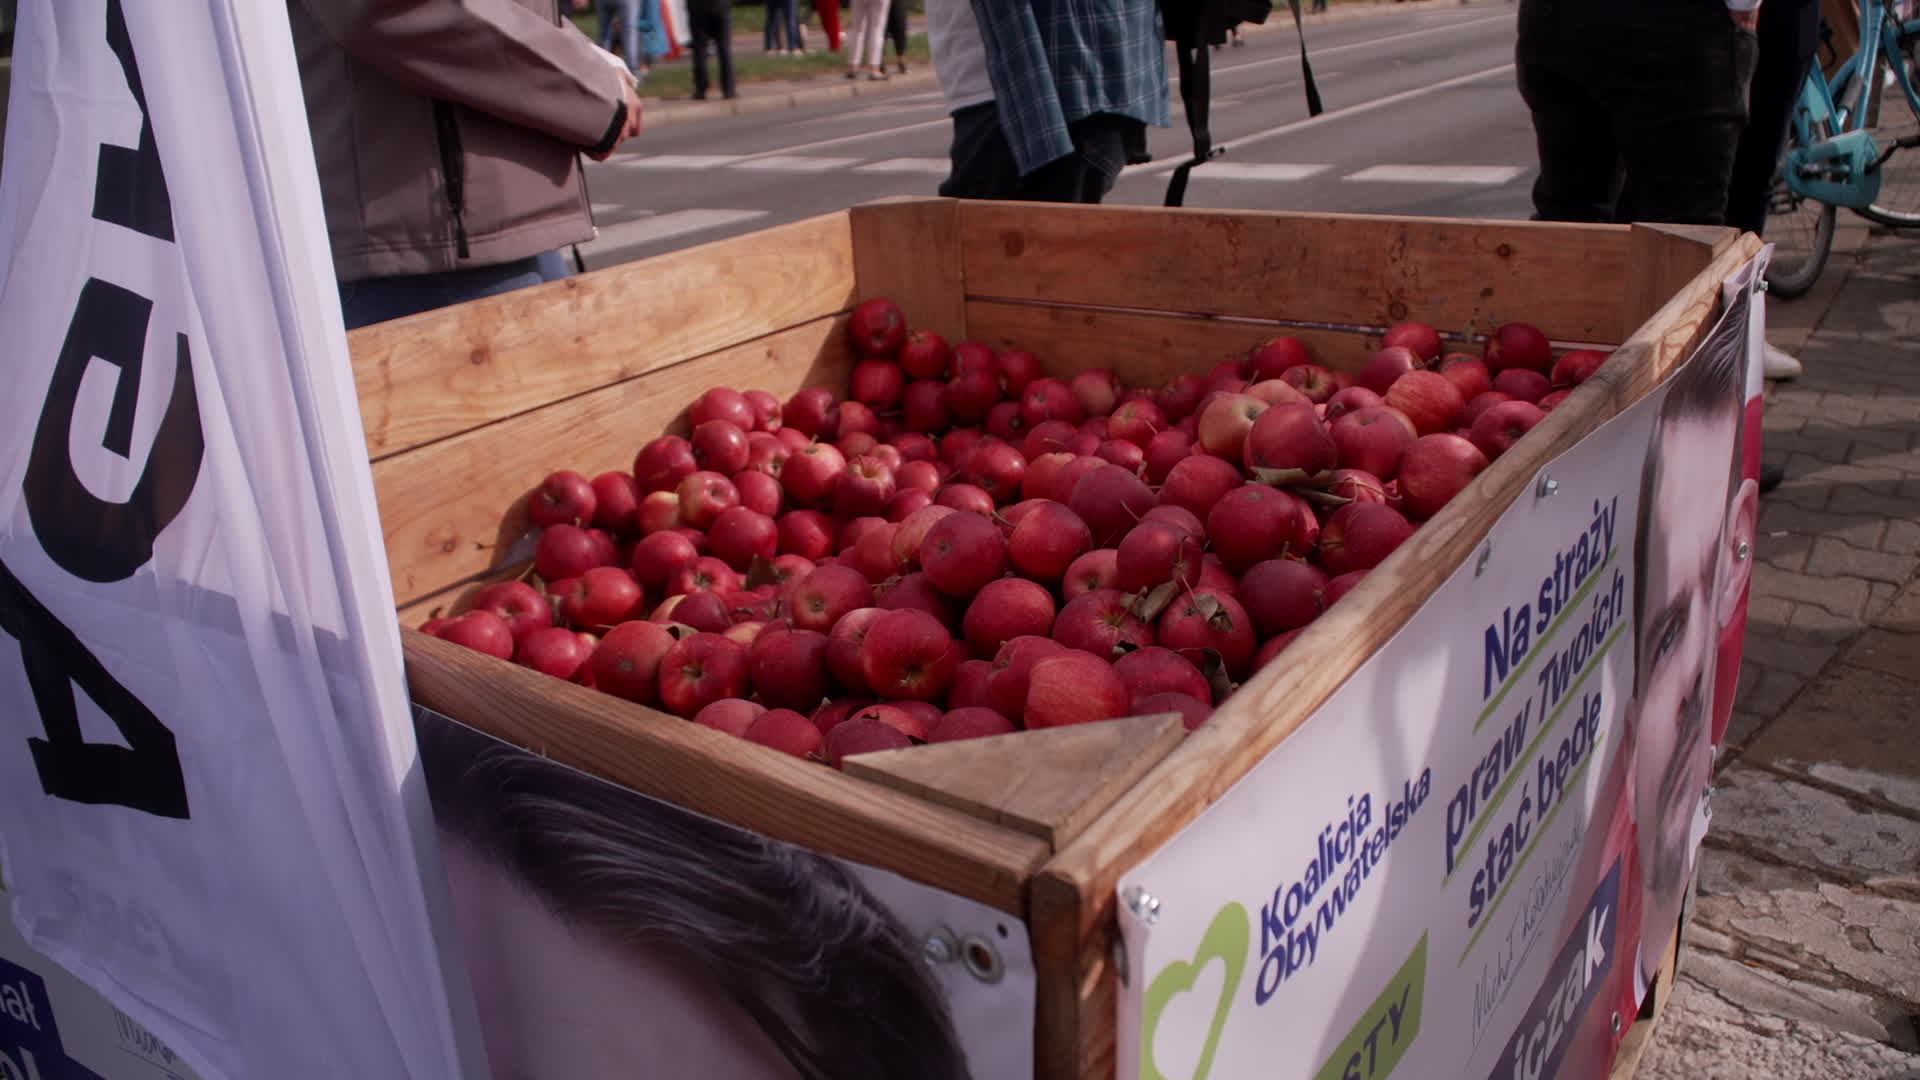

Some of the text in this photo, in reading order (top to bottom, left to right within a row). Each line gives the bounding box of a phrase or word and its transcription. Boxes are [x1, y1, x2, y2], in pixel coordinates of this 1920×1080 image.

[1483, 496, 1618, 700] Na straży
[1446, 697, 1533, 876] praw
[1538, 568, 1625, 725] Twoich
[1468, 782, 1532, 928] stać
[1537, 691, 1603, 822] będę
[1255, 767, 1431, 1006] Obywatelska
[1260, 792, 1372, 960] Koalicja
